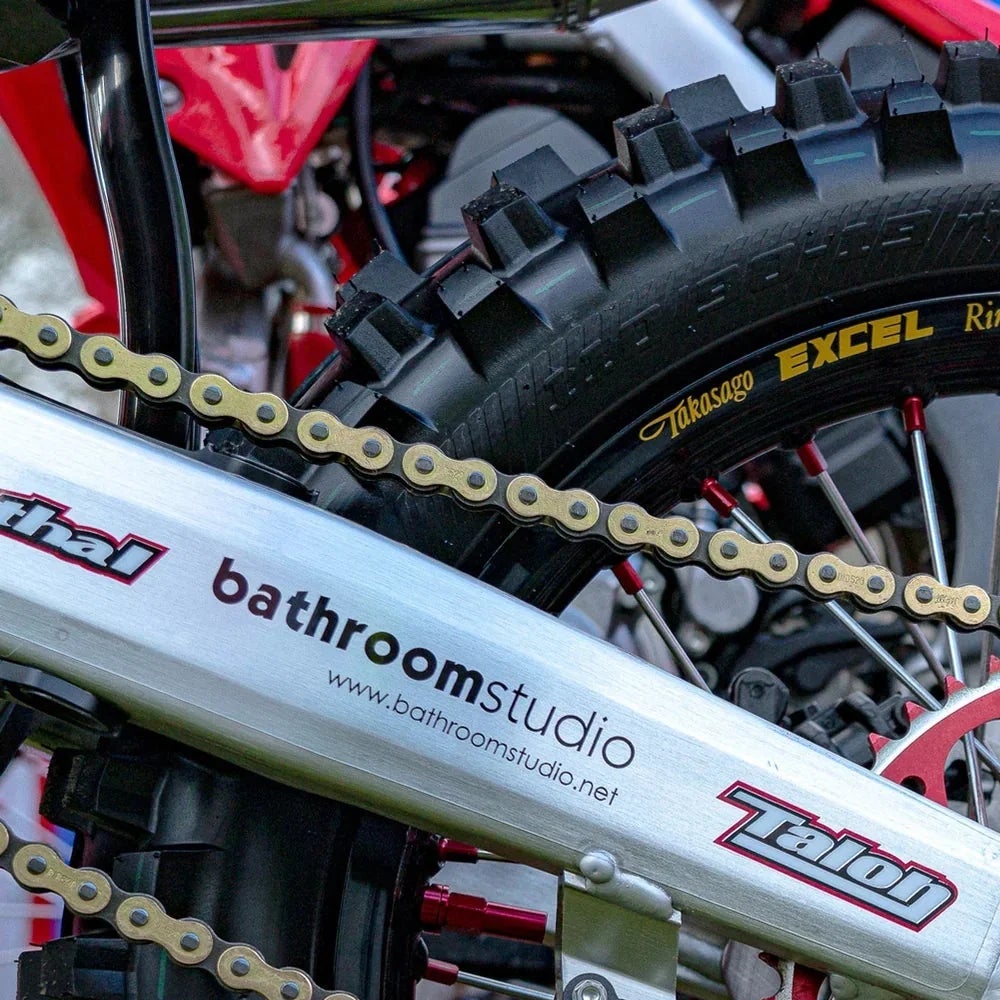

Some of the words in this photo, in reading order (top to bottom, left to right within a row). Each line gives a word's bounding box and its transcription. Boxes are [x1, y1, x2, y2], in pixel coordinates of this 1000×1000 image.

[638, 370, 755, 443] Takasago
[774, 309, 934, 382] EXCEL
[210, 556, 636, 770] bathroomstudio
[327, 669, 619, 806] www.bathroomstudio.net
[722, 784, 957, 928] Talon
